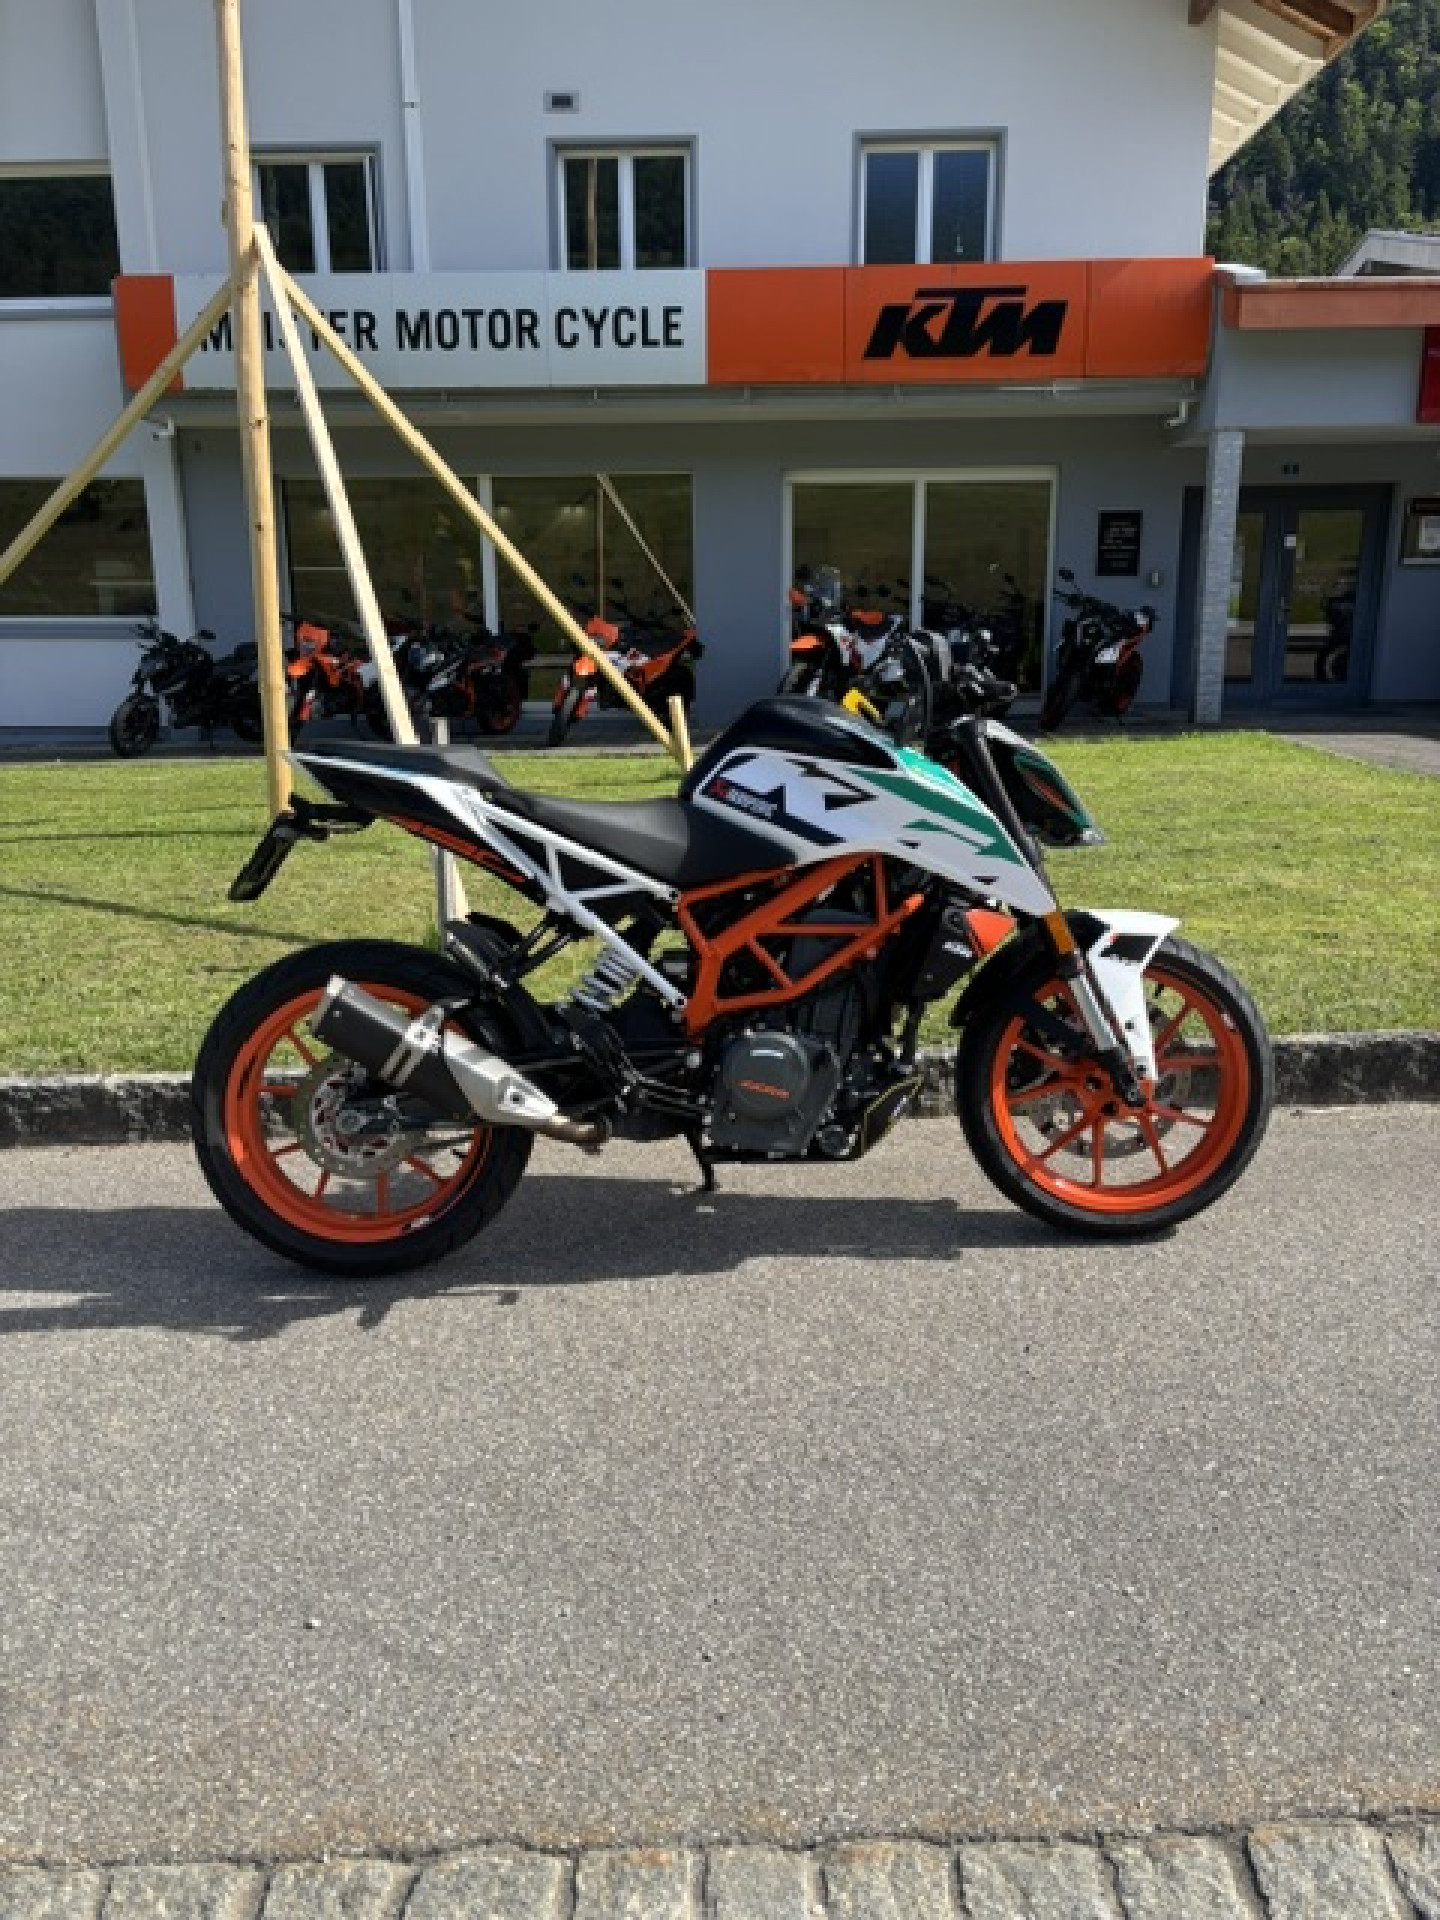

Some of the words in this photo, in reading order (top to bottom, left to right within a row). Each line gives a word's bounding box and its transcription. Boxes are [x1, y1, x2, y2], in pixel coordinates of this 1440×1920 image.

[198, 310, 379, 351] MIER
[396, 308, 541, 351] MOTOR
[555, 306, 683, 348] CYCLE
[864, 286, 1068, 359] KTM
